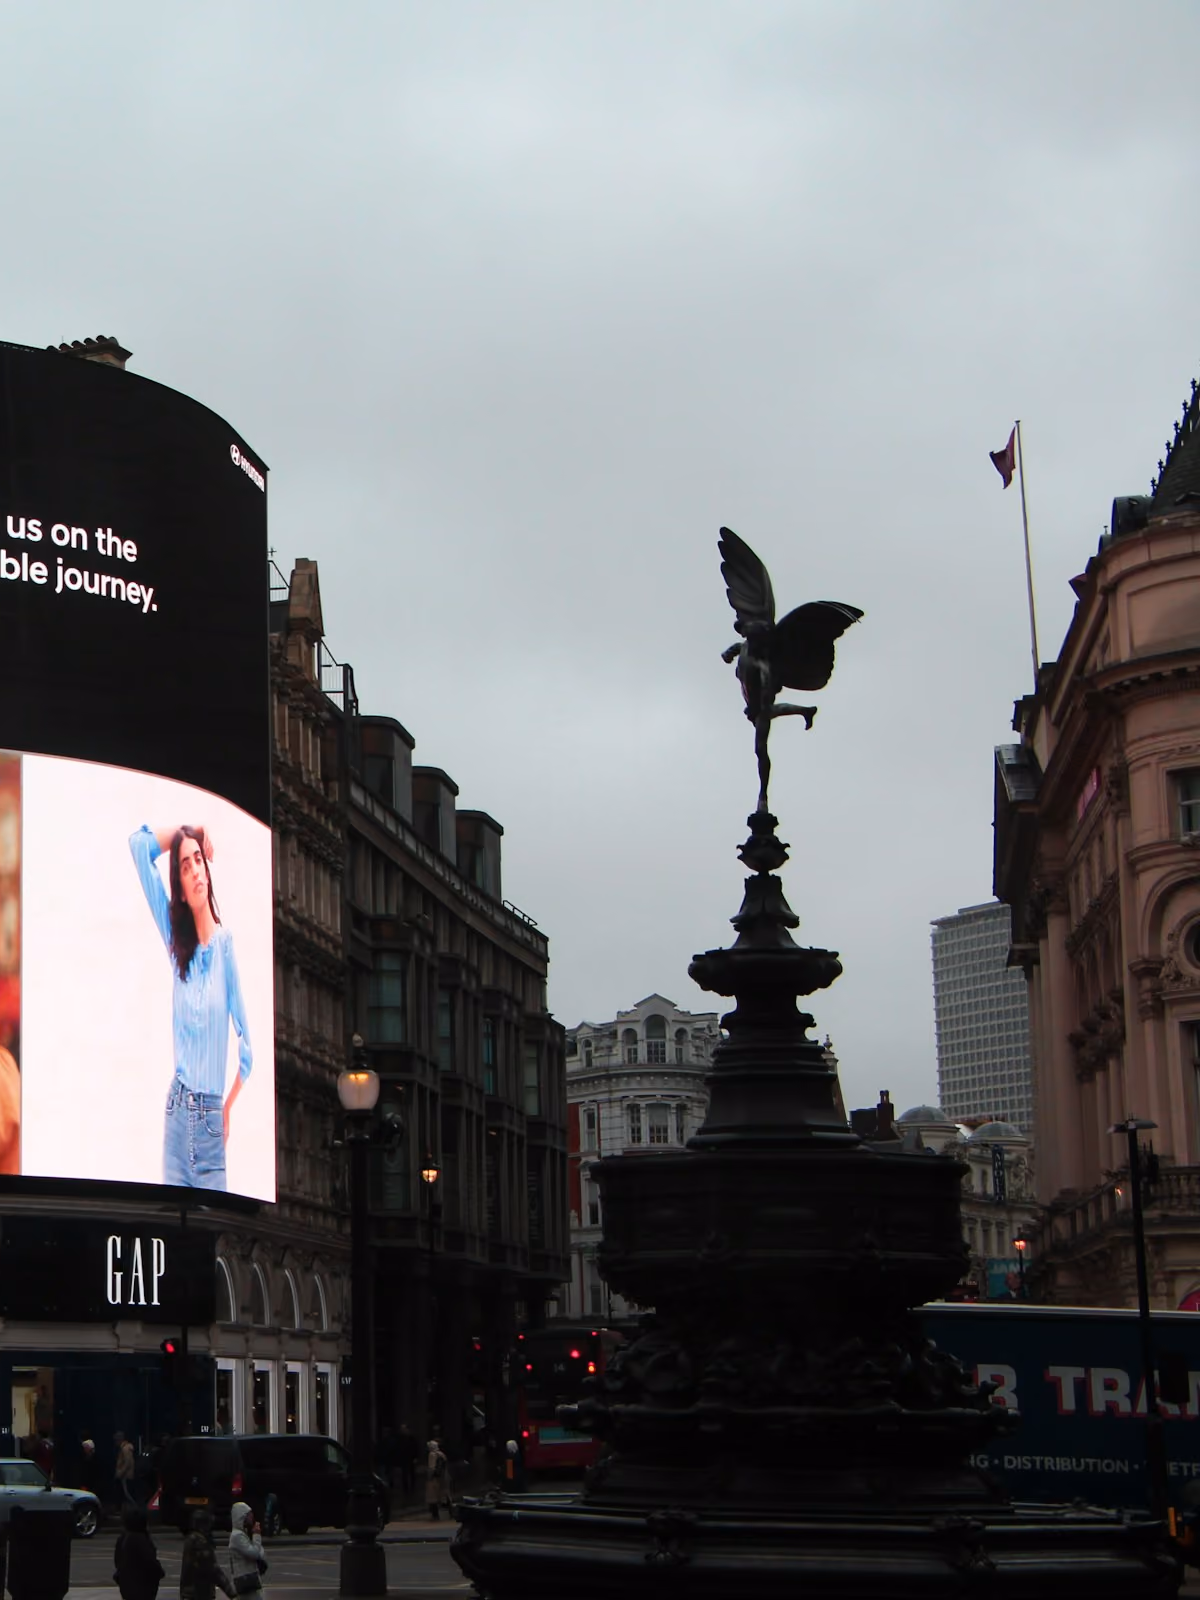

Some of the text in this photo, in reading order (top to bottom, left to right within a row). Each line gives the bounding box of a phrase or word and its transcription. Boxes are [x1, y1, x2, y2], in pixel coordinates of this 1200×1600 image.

[6, 515, 43, 542] us
[51, 523, 87, 551] on
[95, 528, 137, 562] the
[55, 557, 157, 613] journey.
[105, 1235, 167, 1306] GAP
[1003, 1455, 1130, 1474] DISTRIBUTION
